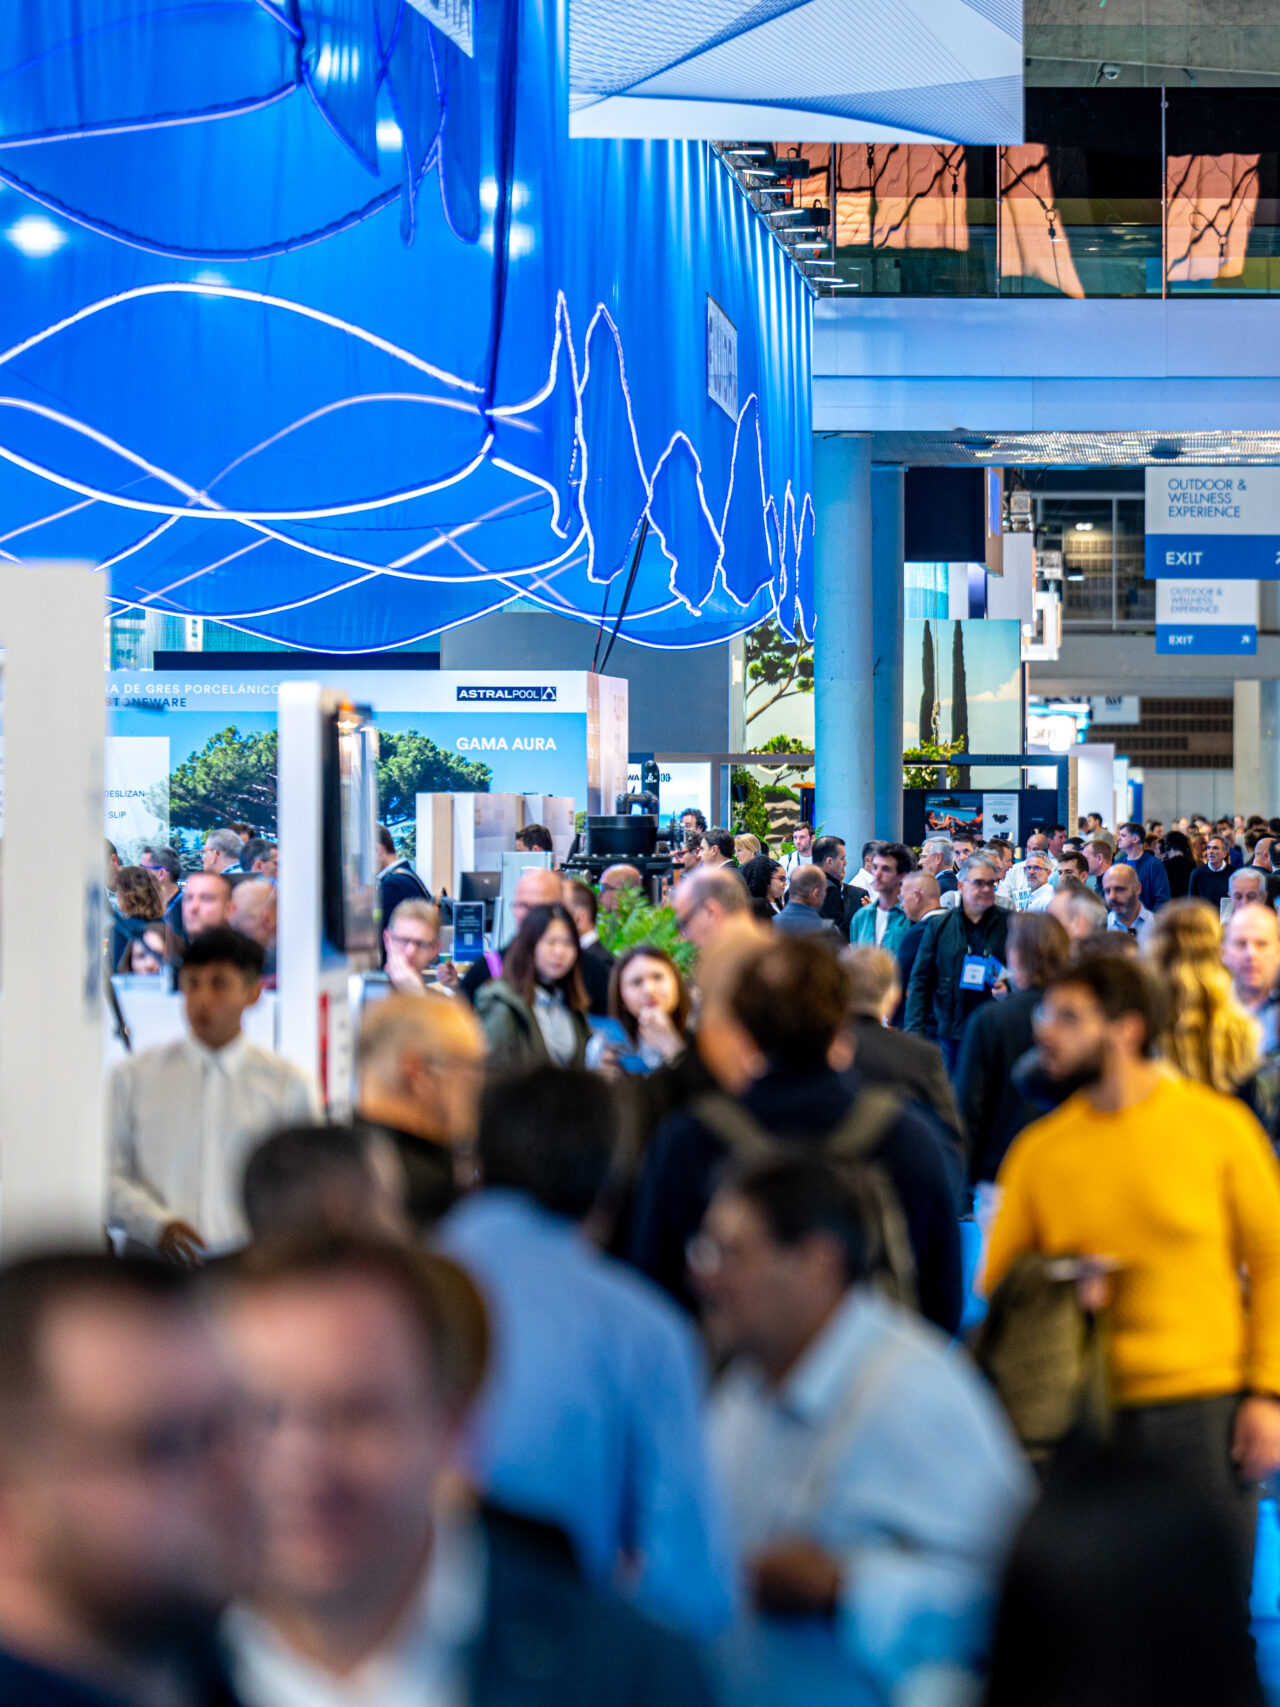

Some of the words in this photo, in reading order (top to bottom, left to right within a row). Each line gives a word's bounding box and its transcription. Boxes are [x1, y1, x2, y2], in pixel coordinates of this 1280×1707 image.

[1168, 478, 1233, 491] OUTDOOR
[1237, 479, 1247, 491] &
[1168, 492, 1232, 504] WELLNESS
[1168, 506, 1240, 518] EXPERIENCE
[1165, 552, 1203, 565] EXIT
[1168, 635, 1194, 645] EXIT
[124, 684, 140, 694] DE
[145, 684, 180, 694] GRES
[458, 689, 539, 699] ASTRALPOOL
[456, 737, 508, 750] GAMA
[511, 737, 557, 750] AURA
[104, 790, 147, 798] DESLIZAN-
